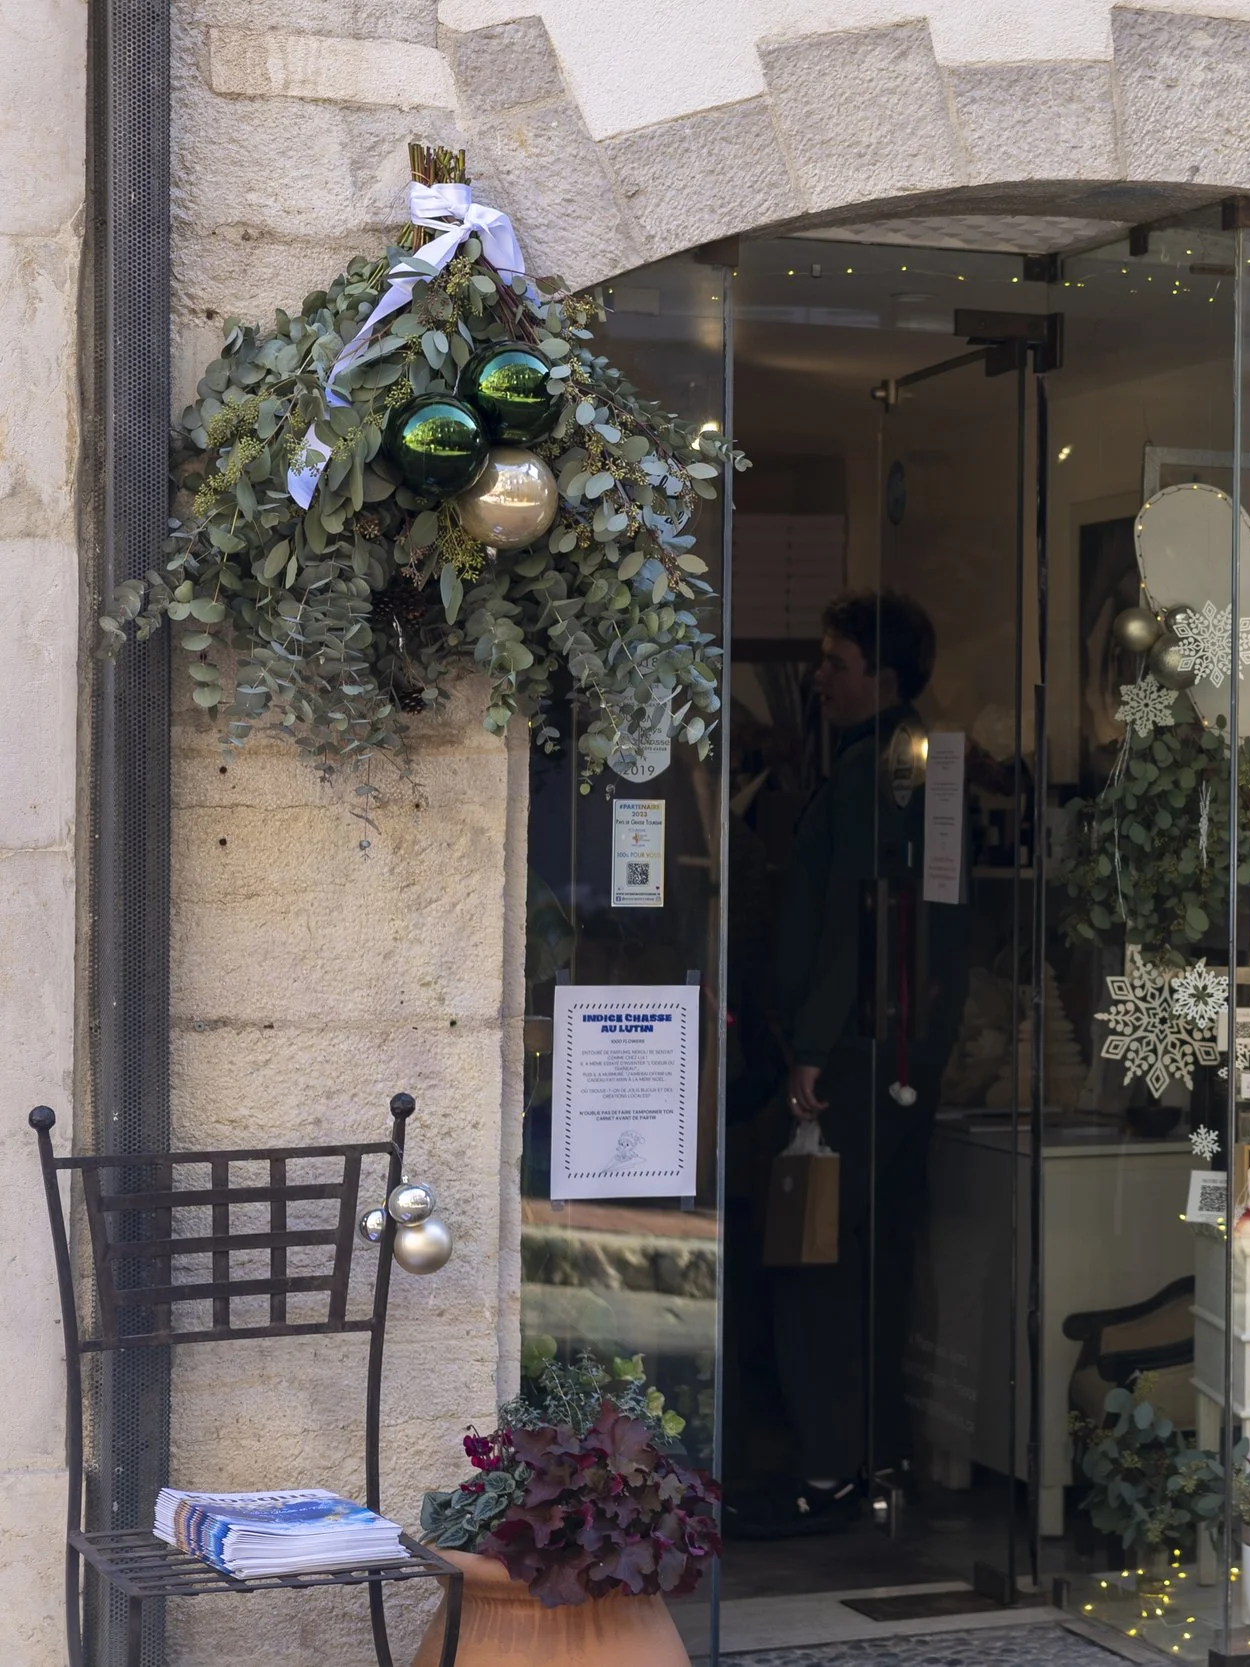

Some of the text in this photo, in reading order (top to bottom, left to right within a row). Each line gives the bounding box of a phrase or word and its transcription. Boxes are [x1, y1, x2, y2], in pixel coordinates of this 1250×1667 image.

[582, 1013, 673, 1023] INDICE CHASSE
[601, 1024, 654, 1033] AU LUTIN
